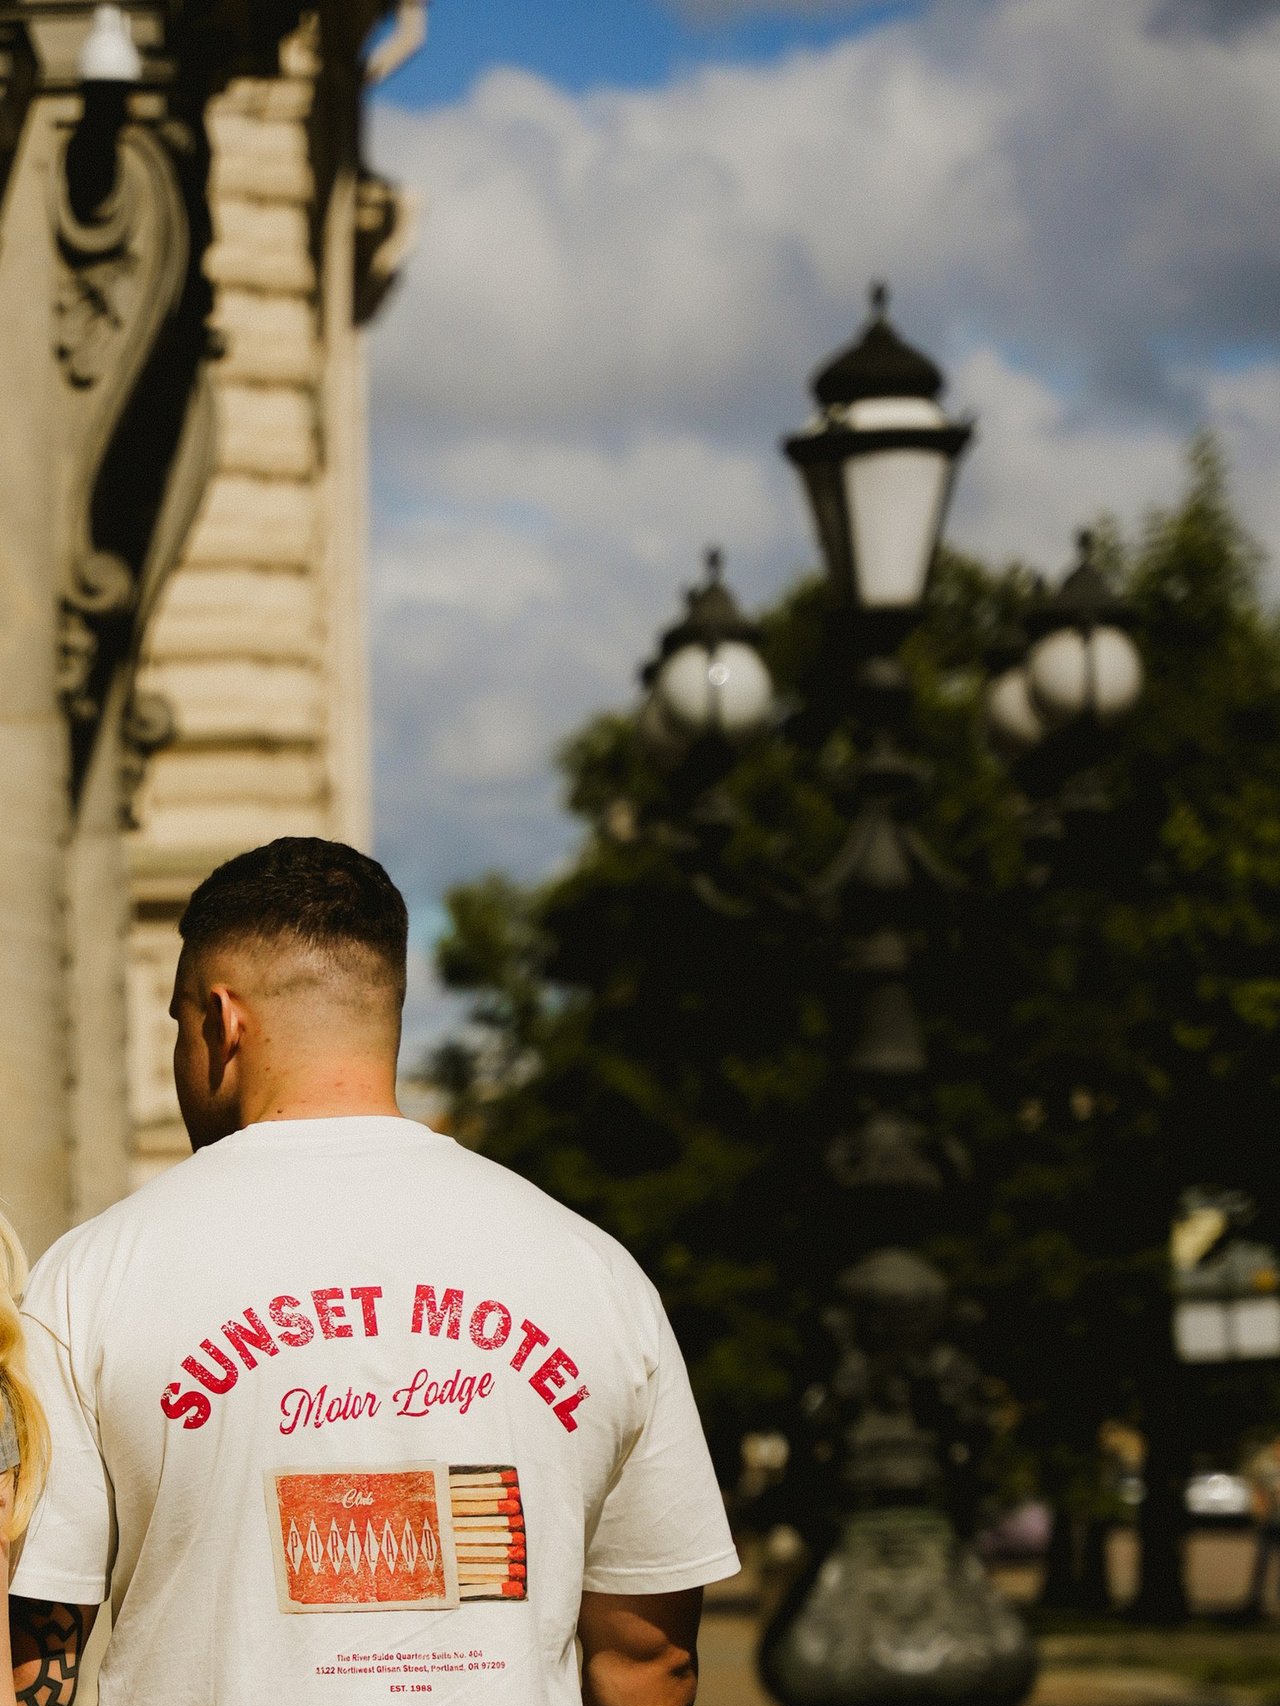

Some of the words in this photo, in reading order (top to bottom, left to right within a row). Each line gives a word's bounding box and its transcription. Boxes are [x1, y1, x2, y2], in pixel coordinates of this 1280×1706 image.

[161, 1286, 382, 1430] SUNSET
[411, 1284, 591, 1433] MOTEL
[279, 1384, 381, 1435] Motor
[392, 1368, 495, 1417] Lodge
[288, 1528, 436, 1564] PORTLAND
[336, 1654, 351, 1662] The
[352, 1653, 371, 1662] River
[337, 1666, 375, 1674] Northwest
[402, 1664, 429, 1674] Street,
[468, 1662, 480, 1671] OR
[481, 1661, 506, 1670] 97209
[410, 1684, 433, 1692] 1988
